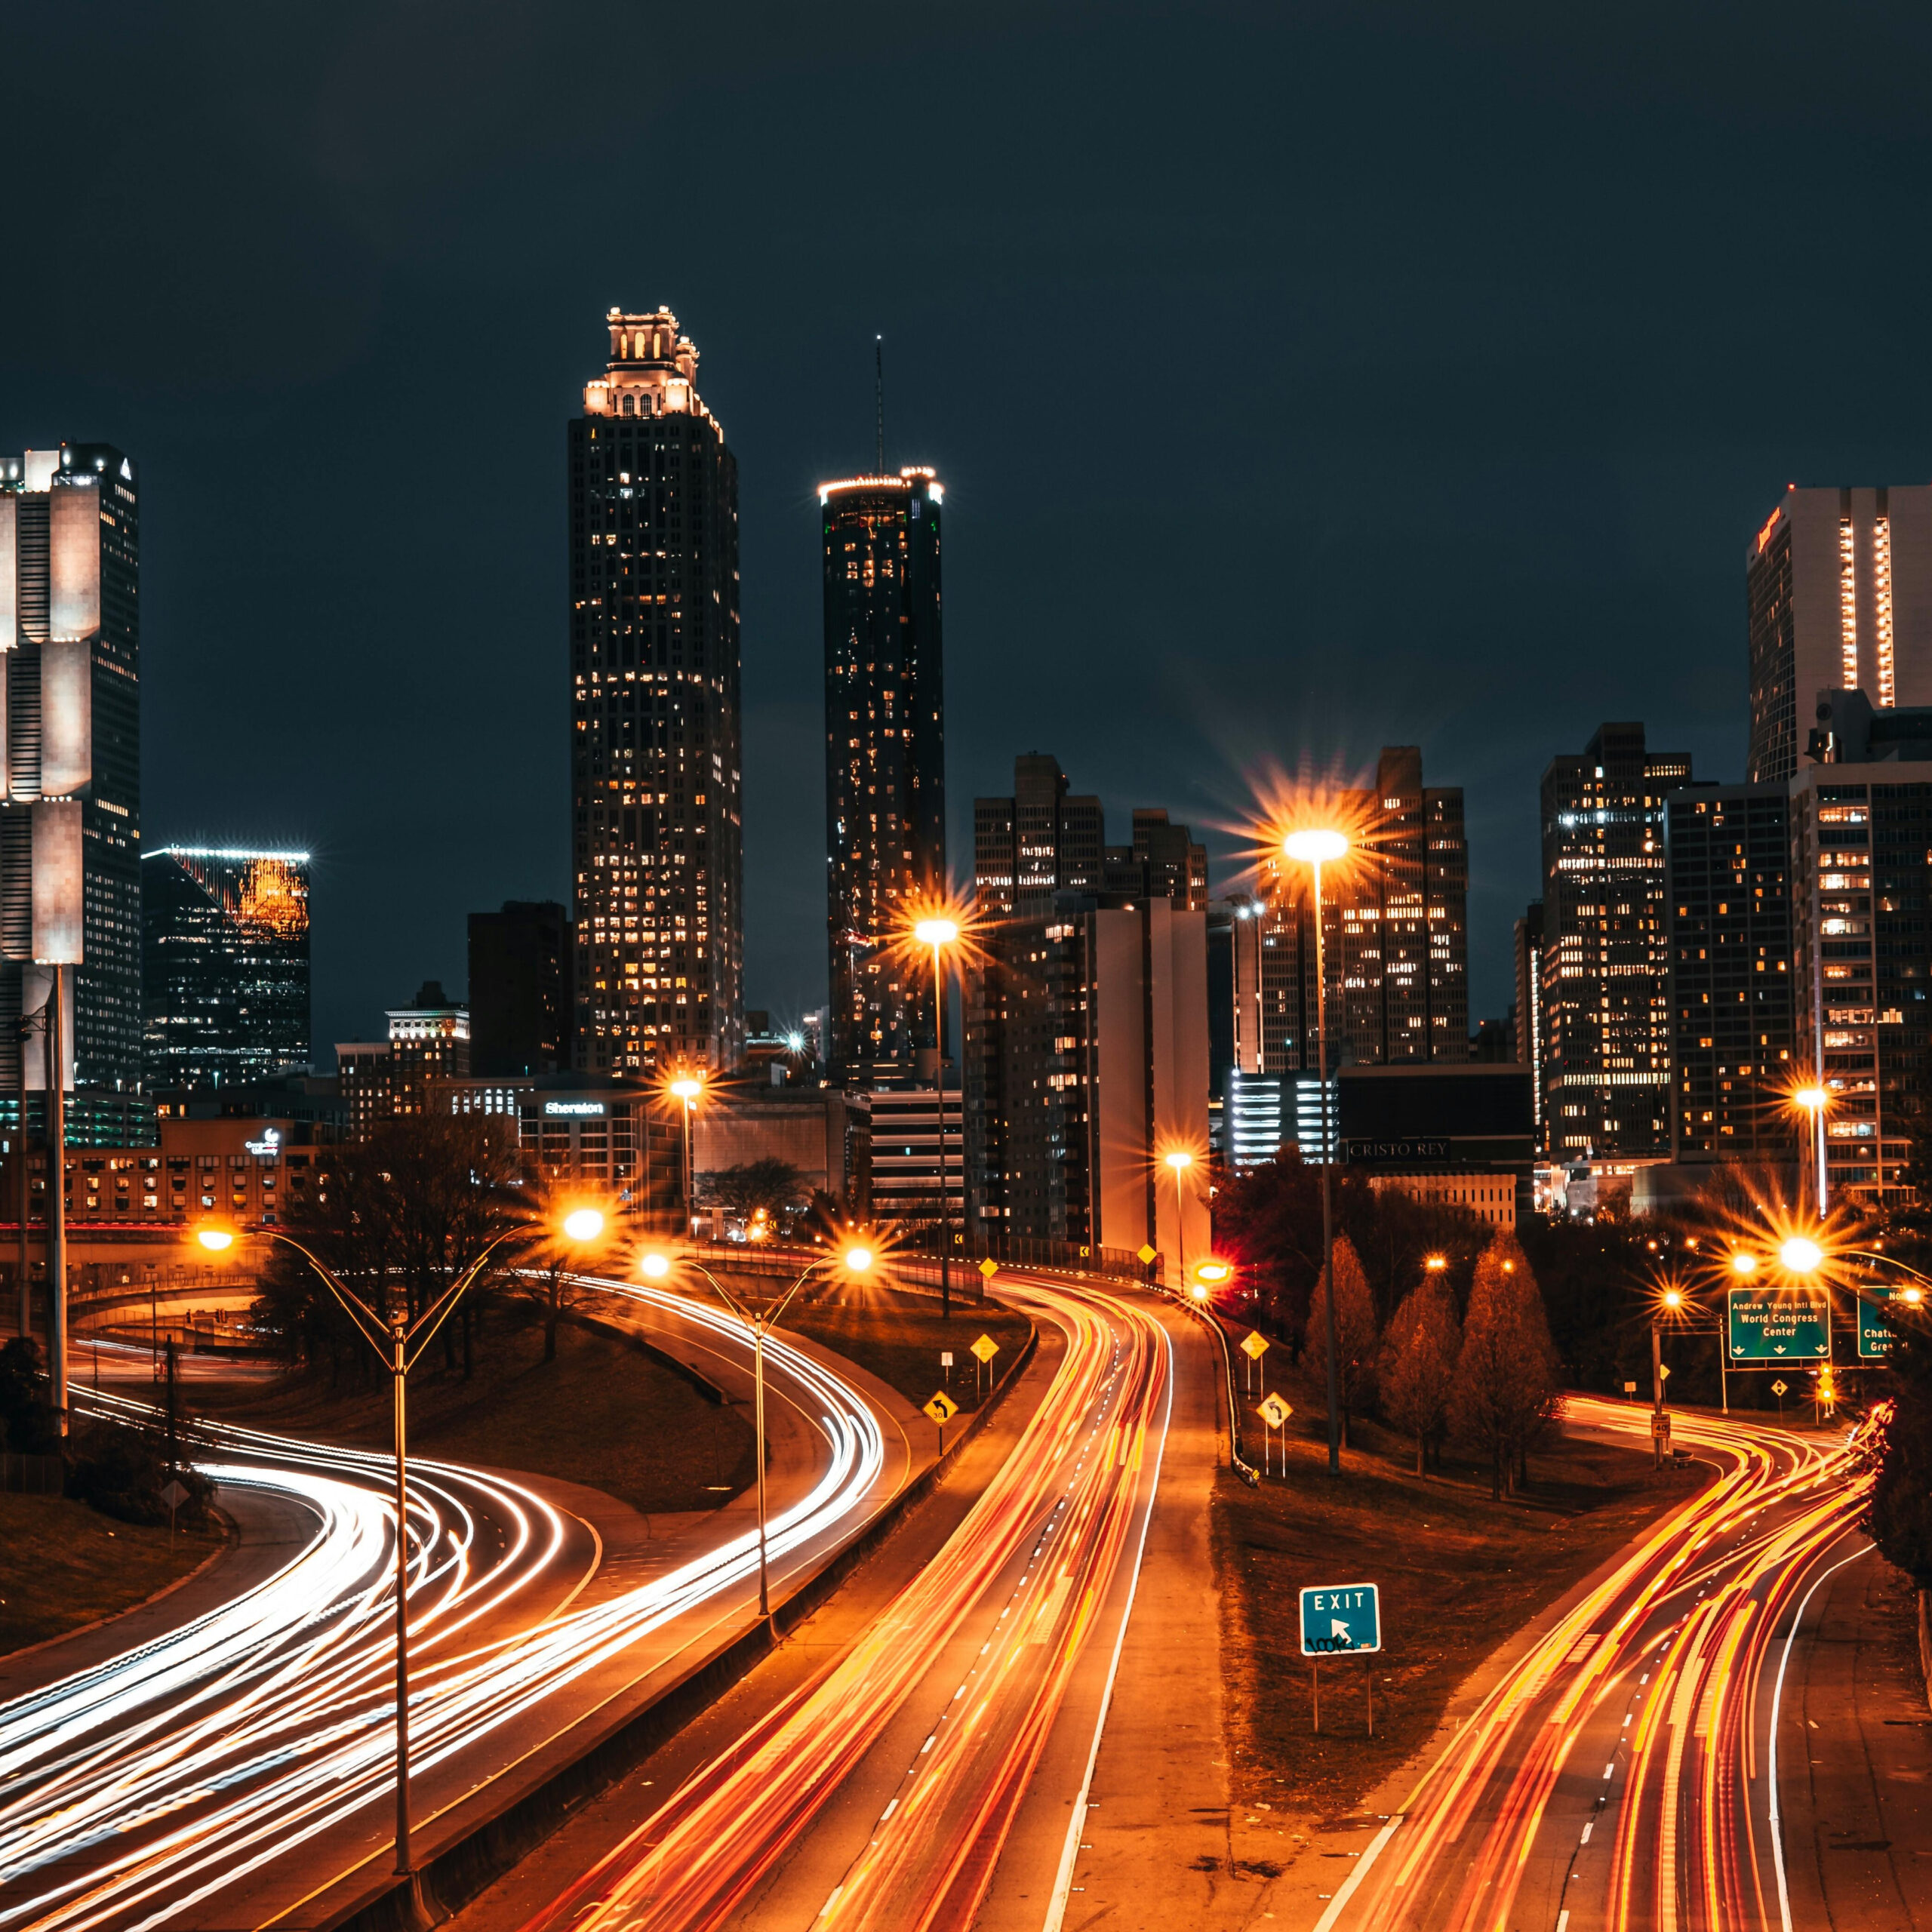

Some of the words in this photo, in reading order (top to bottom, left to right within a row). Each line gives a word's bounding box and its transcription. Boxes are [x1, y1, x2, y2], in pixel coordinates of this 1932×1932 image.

[546, 1102, 603, 1114] Sheraton
[1350, 1143, 1411, 1156] CRISTO
[1417, 1143, 1447, 1155] REY
[1767, 1302, 1792, 1311] Young
[1741, 1314, 1768, 1323] World
[1773, 1314, 1818, 1324] Congress
[1763, 1327, 1796, 1337] Center
[1314, 1592, 1364, 1611] EXIT
